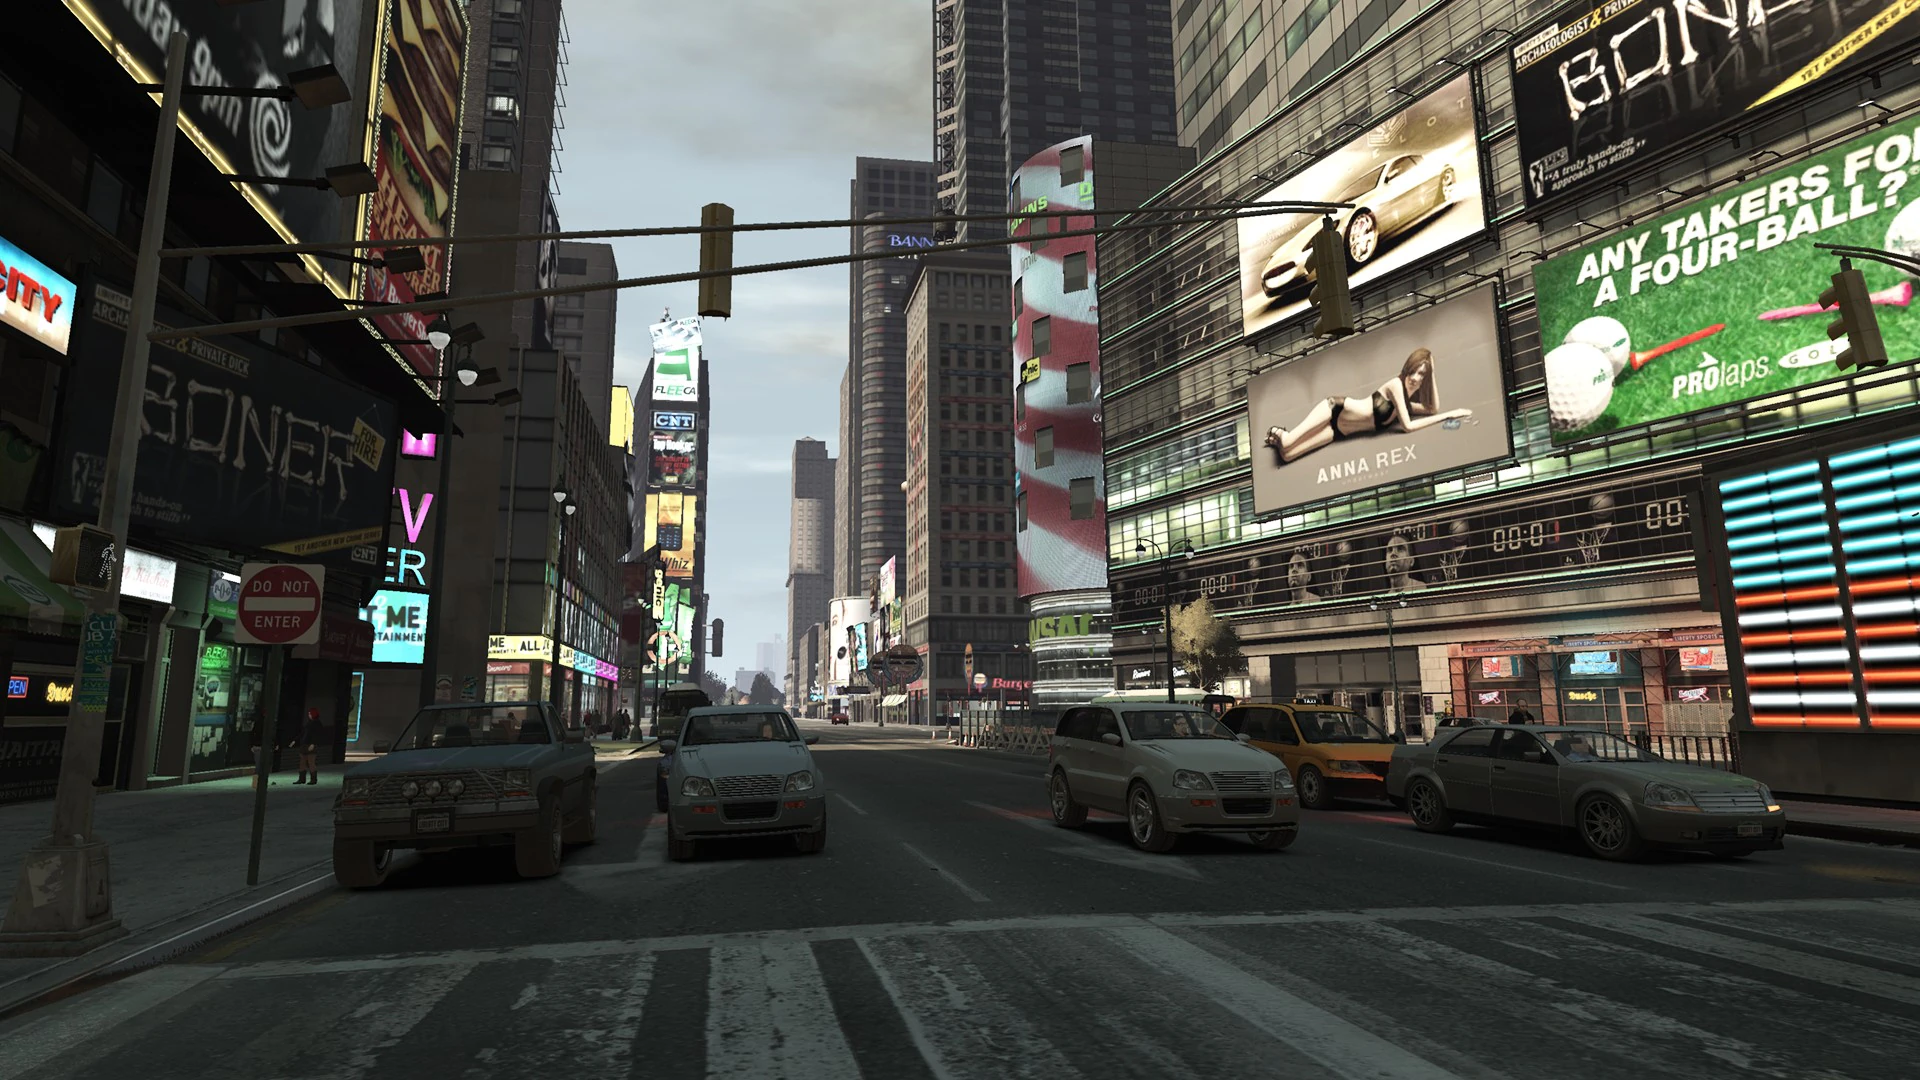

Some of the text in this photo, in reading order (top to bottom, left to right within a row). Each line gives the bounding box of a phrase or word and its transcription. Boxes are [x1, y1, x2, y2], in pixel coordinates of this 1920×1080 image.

[1515, 19, 1589, 70] ARCHAEOLOGIST
[1589, 8, 1603, 30] &
[1823, 26, 1873, 67] ANOTHER
[1586, 137, 1635, 165] hands-on
[1551, 166, 1596, 191] approach
[1597, 160, 1609, 170] to
[1576, 230, 1651, 286] ANY
[1660, 165, 1830, 251] TAKERS
[1593, 170, 1908, 308] A FOUR-BALL?
[191, 339, 228, 367] PRIVATE
[228, 357, 250, 376] DICK
[654, 384, 696, 397] FLEECA
[656, 415, 692, 427] CNT
[359, 426, 378, 446] FOR
[353, 437, 379, 465] HIRE
[1317, 443, 1417, 484] ANNA REX
[353, 547, 376, 561] CNT
[253, 581, 310, 593] DO NOT
[254, 615, 301, 628] ENTER
[519, 641, 541, 652] ALL
